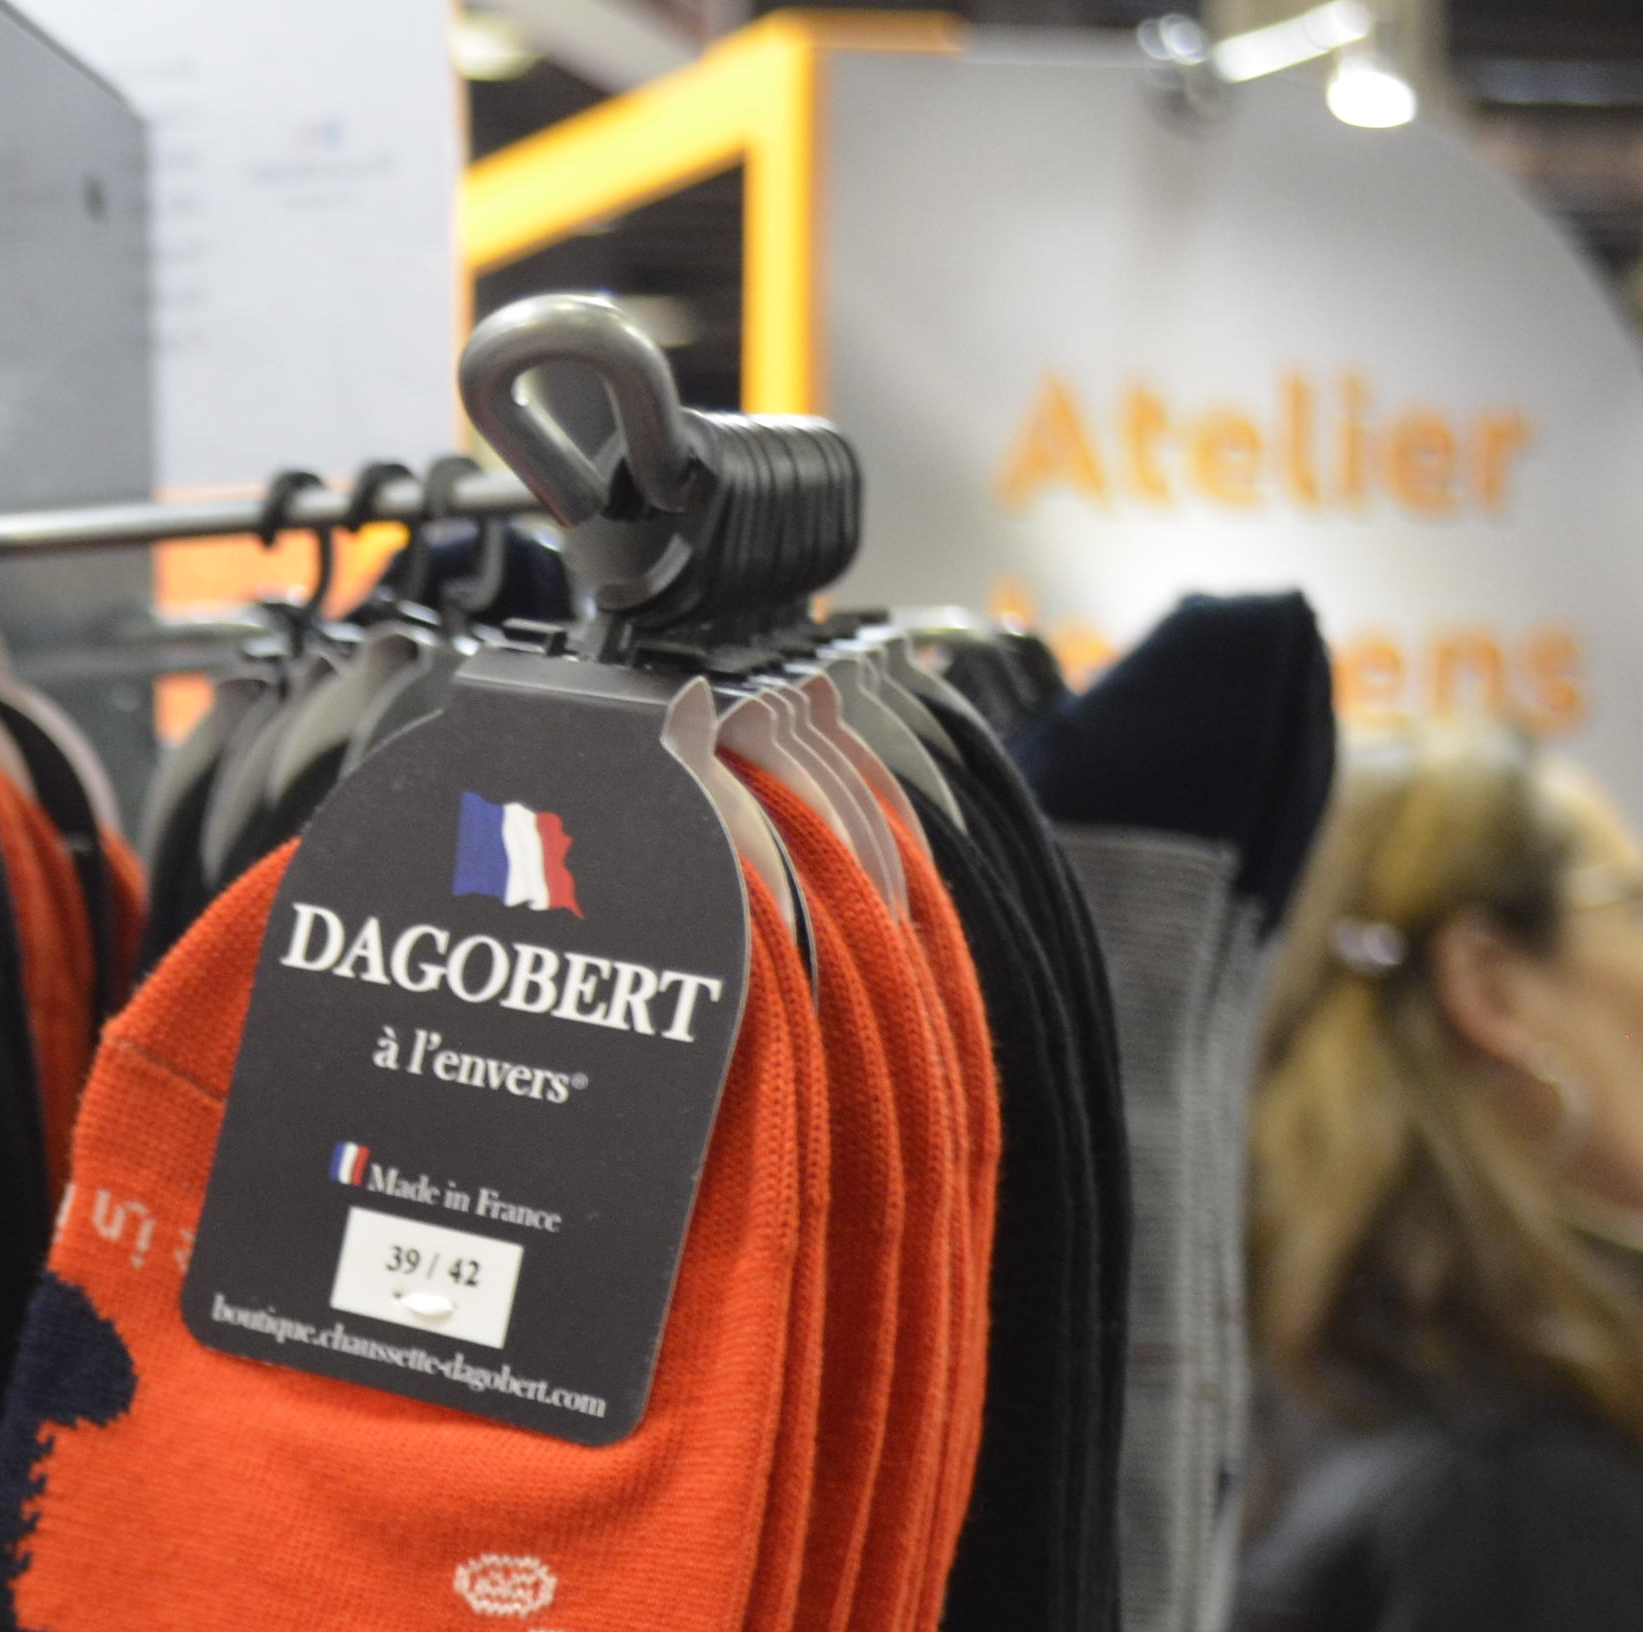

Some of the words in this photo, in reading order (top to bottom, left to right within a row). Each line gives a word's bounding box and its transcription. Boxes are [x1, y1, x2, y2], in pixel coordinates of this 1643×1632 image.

[1000, 372, 1537, 518] Atelier
[281, 903, 721, 1042] DAGOBERT
[373, 1026, 399, 1068] à
[366, 1162, 438, 1203] Made
[444, 1180, 469, 1210] in
[475, 1188, 561, 1232] France
[385, 1245, 421, 1274] 39
[447, 1259, 481, 1287] 42
